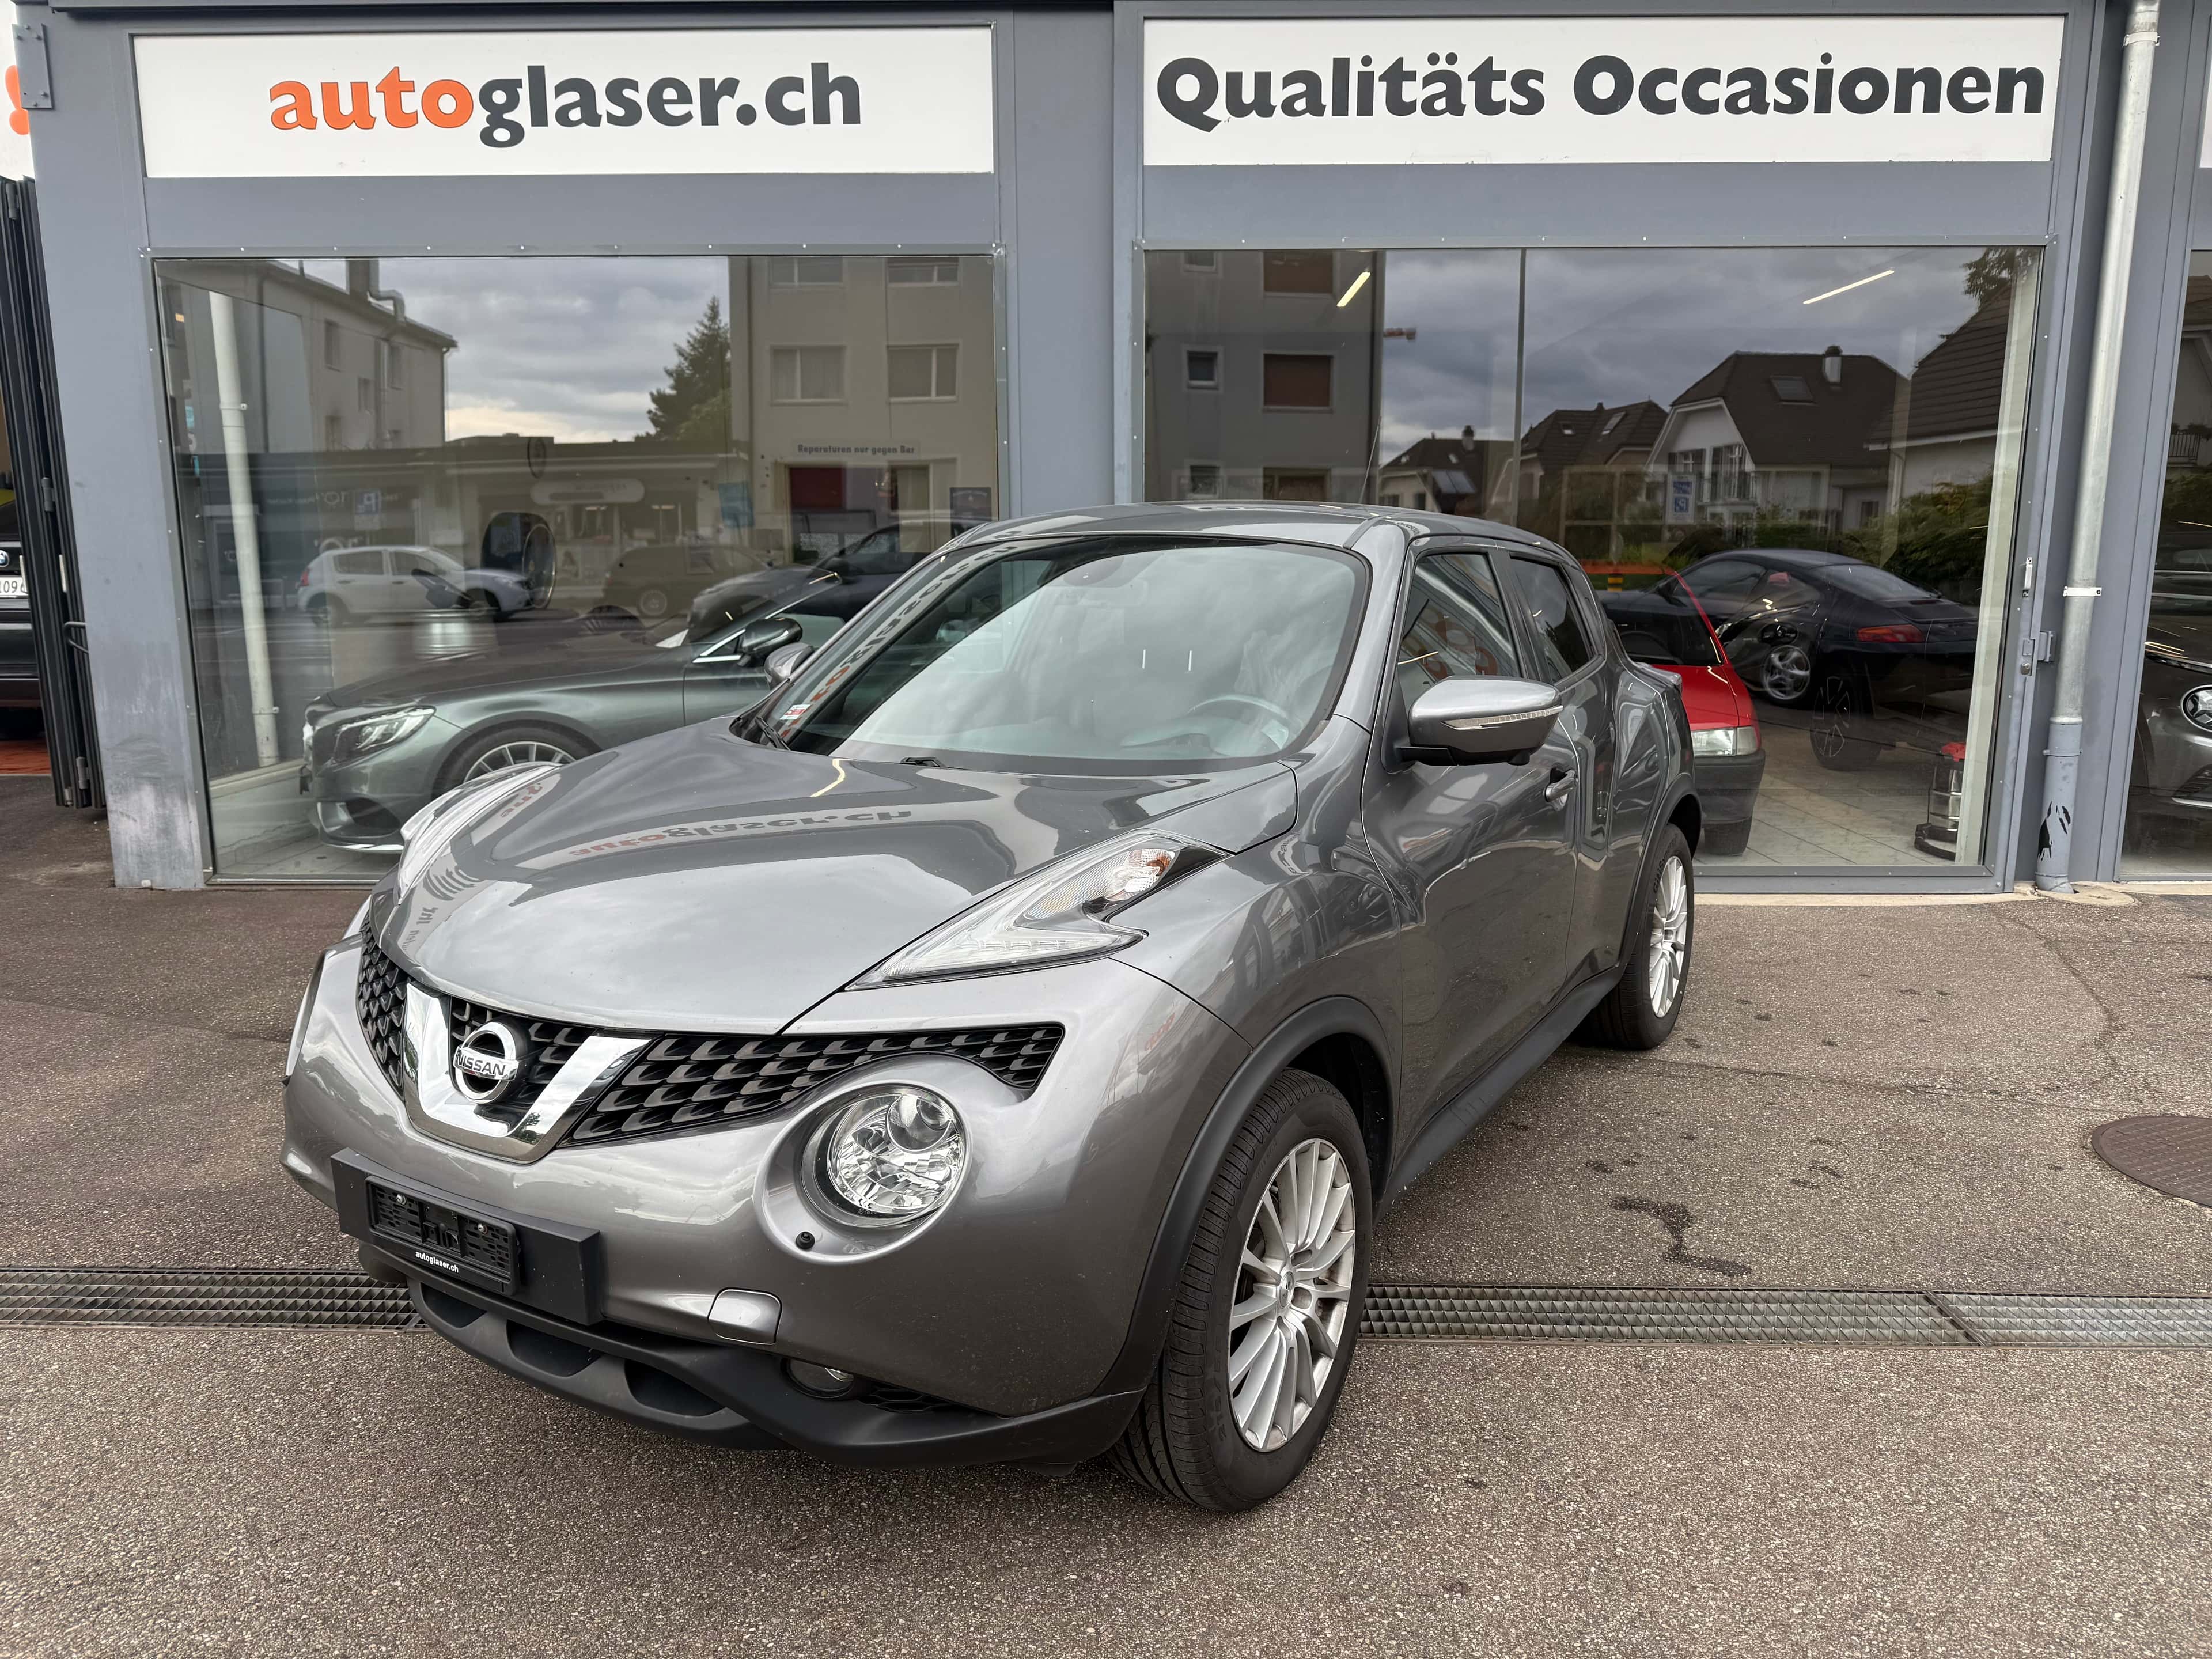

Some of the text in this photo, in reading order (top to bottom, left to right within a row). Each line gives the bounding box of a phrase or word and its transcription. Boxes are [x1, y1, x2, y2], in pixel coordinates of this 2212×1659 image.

[270, 62, 861, 148] autoglaser.ch
[1157, 52, 2045, 133] Qualitäts Occasionen
[797, 444, 851, 454] Reparaturen
[871, 446, 897, 455] gegen
[900, 445, 915, 453] Bar
[456, 1049, 506, 1075] NISSAN
[415, 1251, 459, 1273] autoglaser.ch
